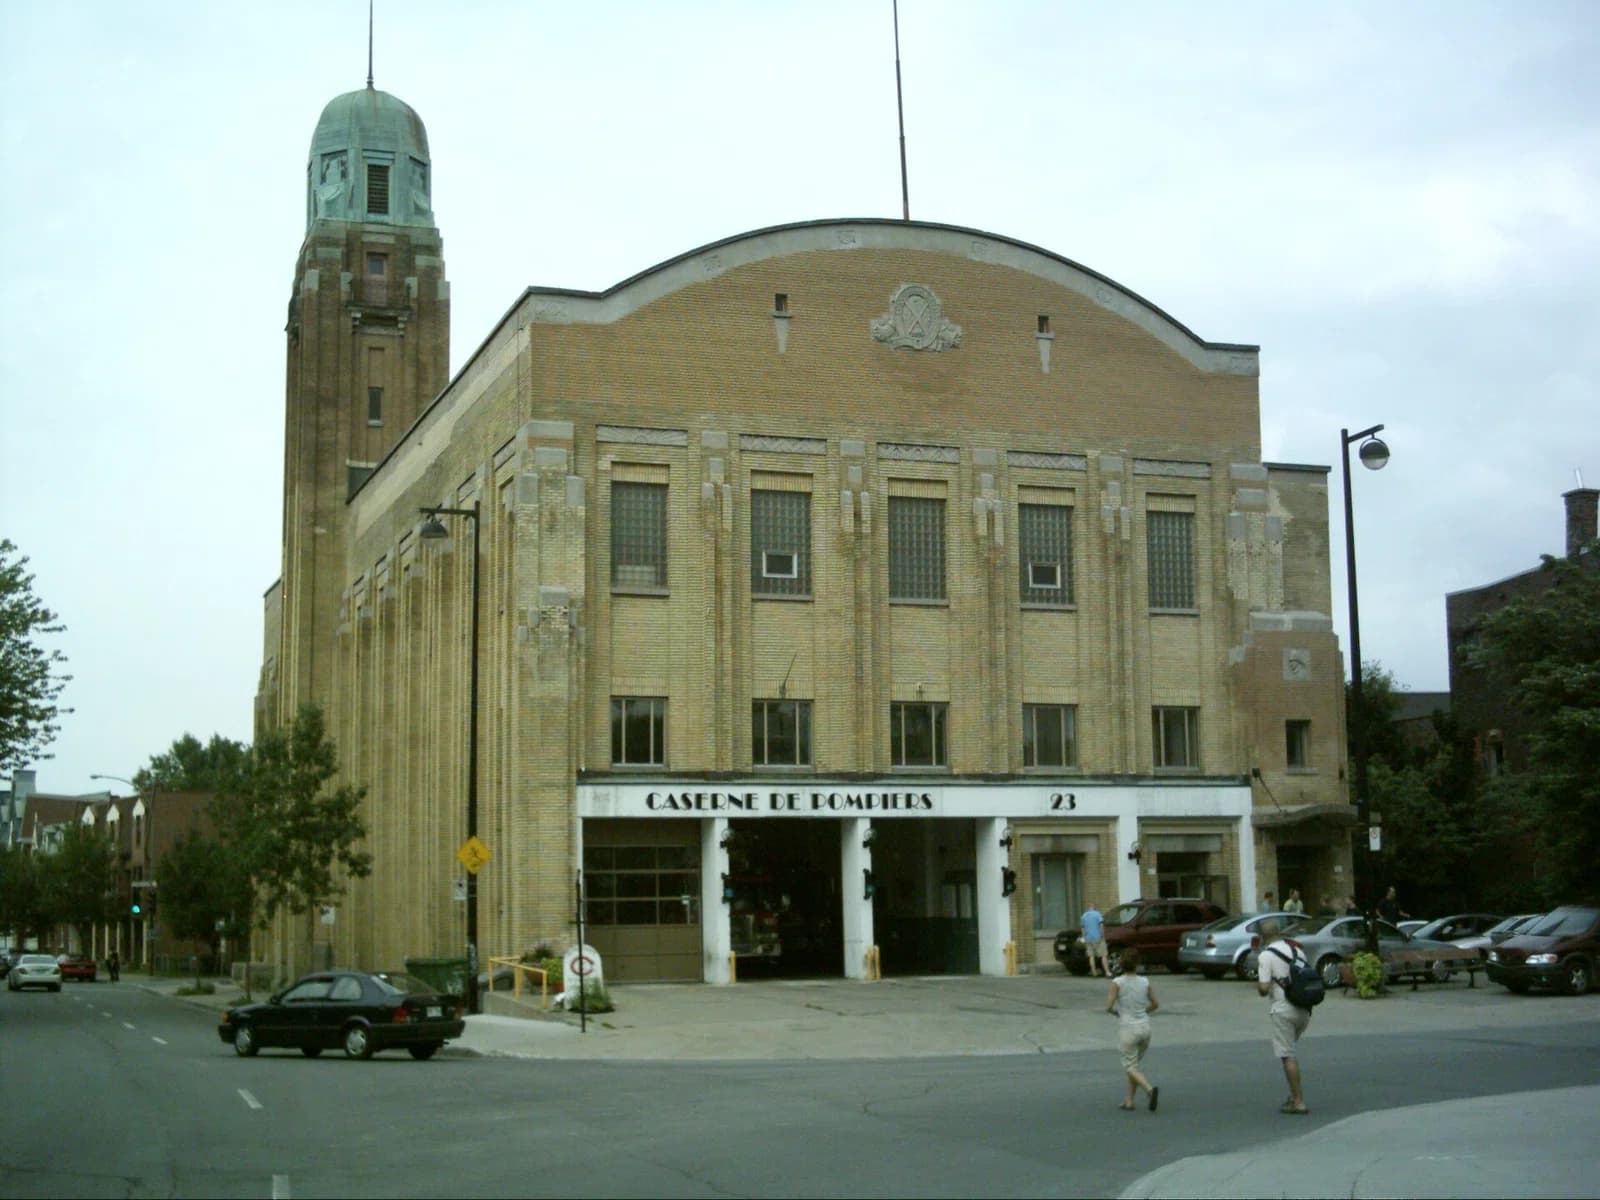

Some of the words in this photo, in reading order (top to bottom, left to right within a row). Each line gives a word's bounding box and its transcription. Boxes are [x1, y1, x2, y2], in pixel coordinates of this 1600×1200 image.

[645, 792, 759, 811] CASERNE
[769, 792, 801, 811] DE
[811, 792, 933, 811] POMPIERS
[1050, 793, 1076, 810] 23
